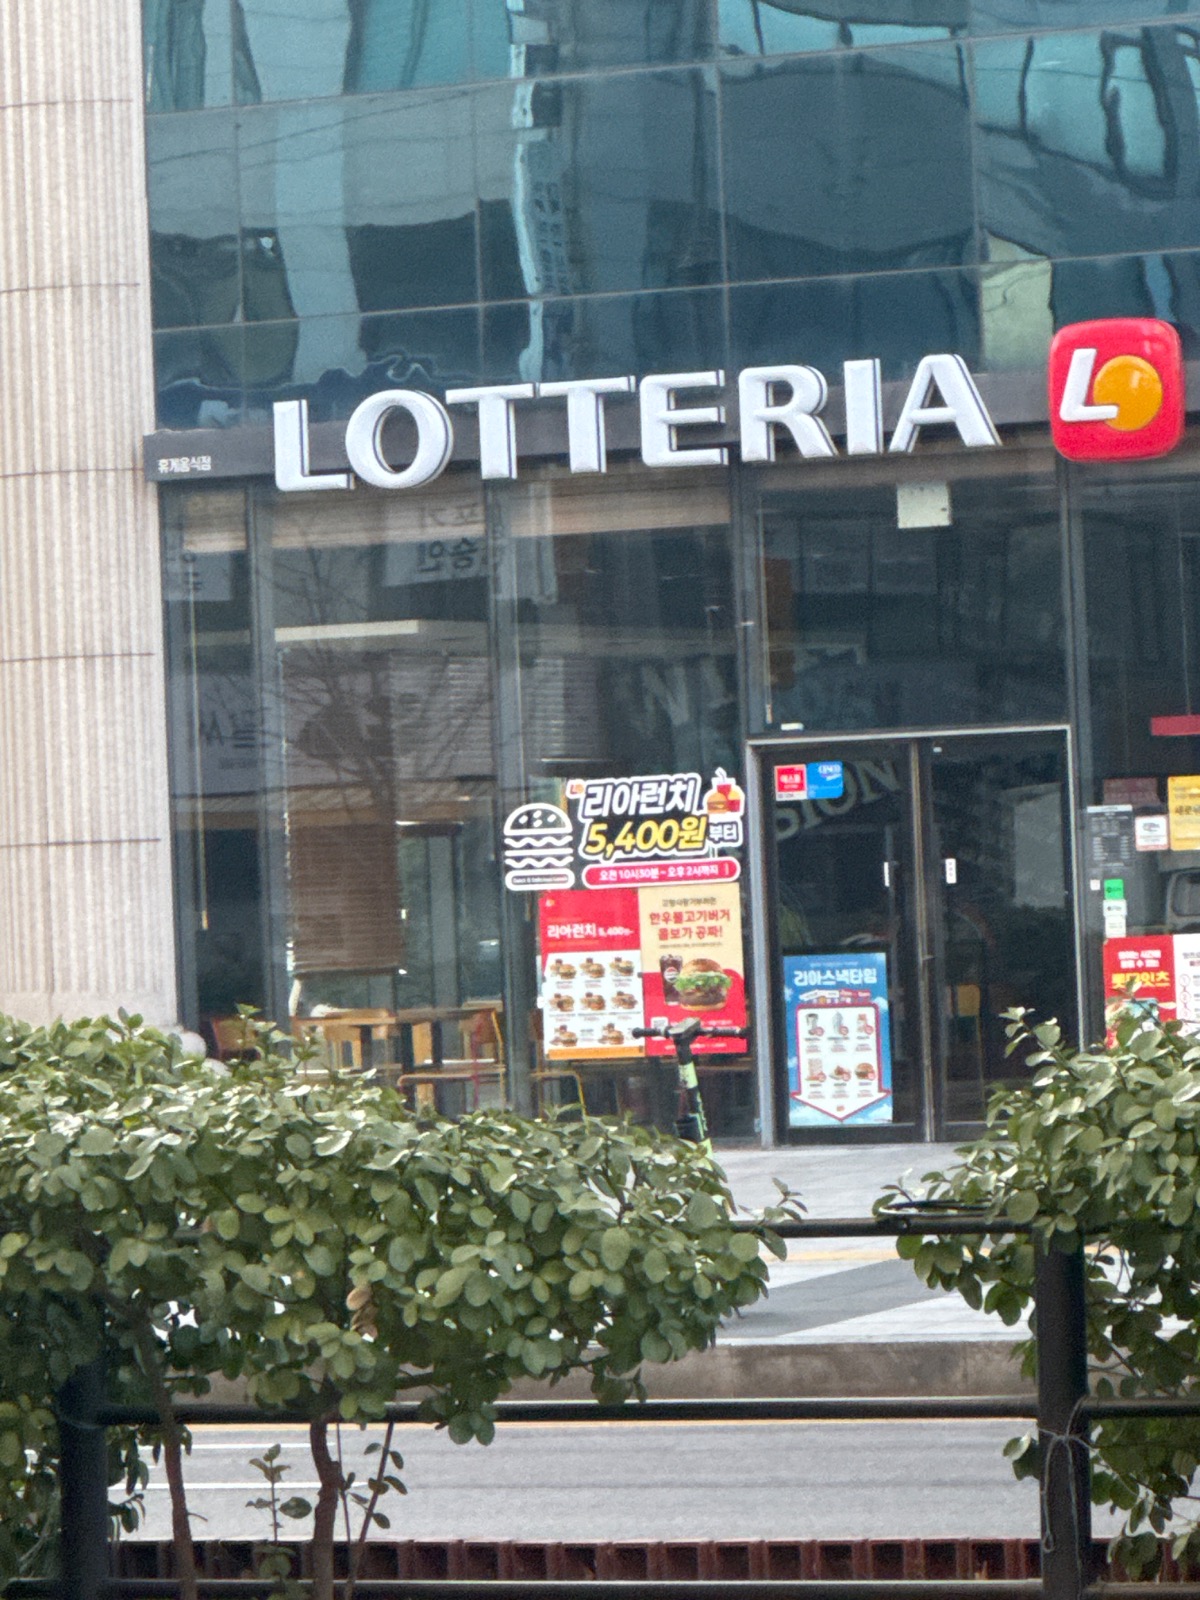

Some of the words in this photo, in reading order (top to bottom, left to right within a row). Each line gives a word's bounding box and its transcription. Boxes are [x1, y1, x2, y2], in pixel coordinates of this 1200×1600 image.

[273, 353, 1003, 492] LOTTERIA
[158, 455, 211, 473] 휴게음식점
[585, 779, 695, 817] 리아런치
[585, 816, 708, 858] 5,400원
[709, 824, 737, 840] 부터
[599, 870, 618, 881] 오전
[668, 866, 685, 877] 오후
[547, 923, 597, 938] 리아런치
[794, 967, 878, 986] 리아스낵타임
